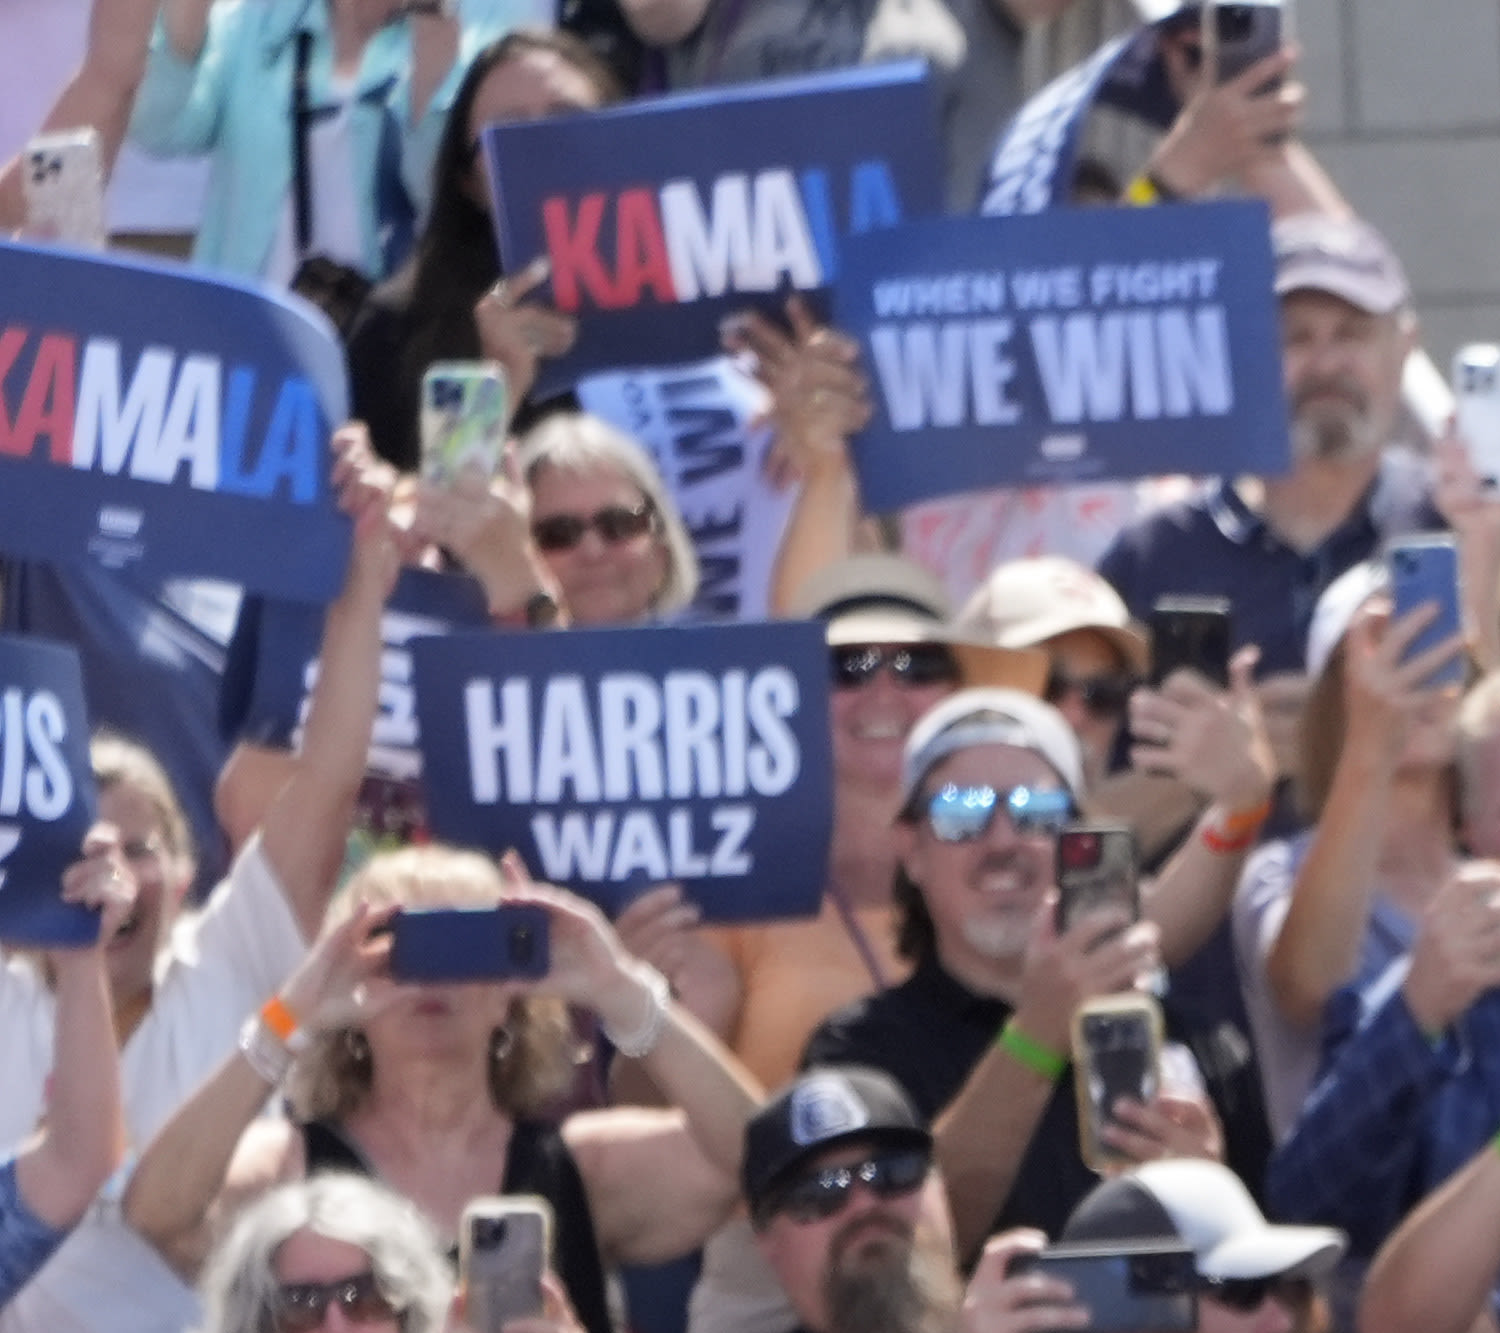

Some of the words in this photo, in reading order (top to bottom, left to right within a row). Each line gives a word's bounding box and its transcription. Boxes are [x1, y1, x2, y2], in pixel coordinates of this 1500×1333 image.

[872, 271, 1005, 318] WHEN
[1010, 265, 1083, 310] WE
[1089, 257, 1222, 305] FIGHT
[869, 317, 1023, 433] WE
[1029, 303, 1234, 424] WIN
[463, 664, 800, 806] HARRIS
[529, 805, 755, 883] WALZ
